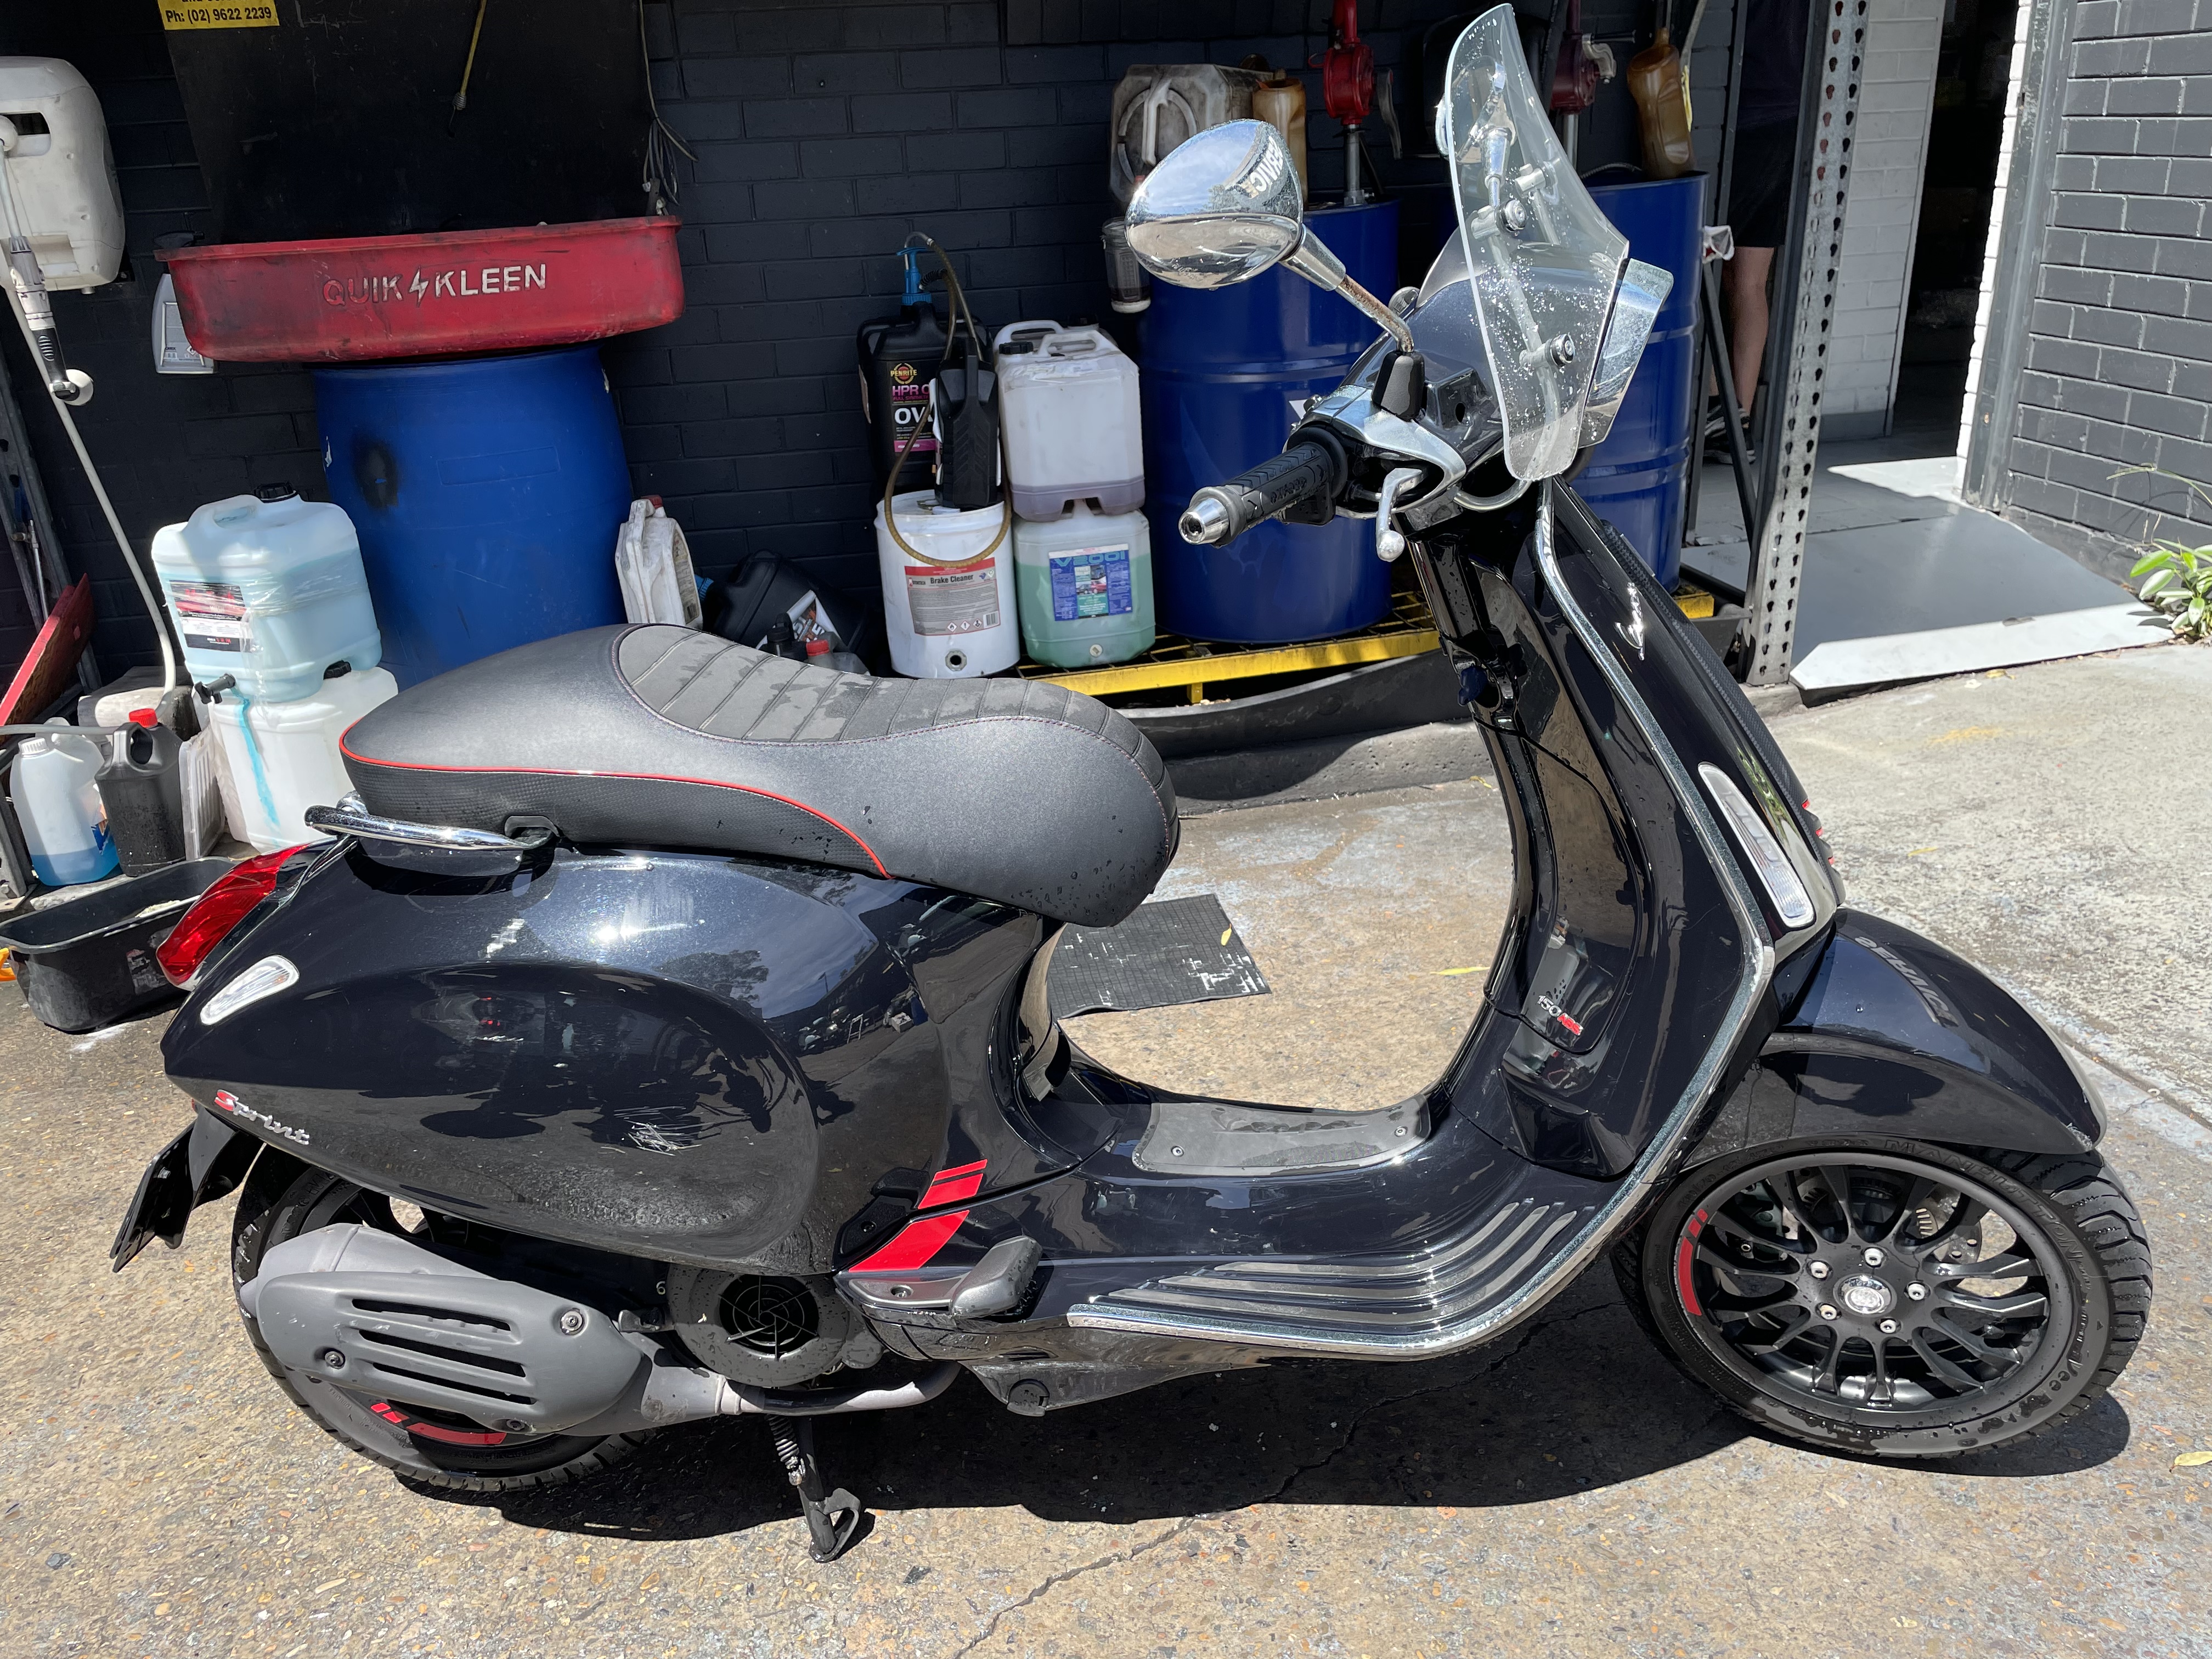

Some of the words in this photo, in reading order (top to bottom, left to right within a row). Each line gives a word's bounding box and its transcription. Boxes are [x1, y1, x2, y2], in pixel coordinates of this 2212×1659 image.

[166, 10, 184, 22] Ph:
[188, 8, 210, 24] (02)
[213, 8, 242, 20] 9622
[245, 7, 271, 20] 2239
[323, 276, 403, 306] QUIK
[436, 264, 546, 298] KLEEN
[890, 369, 918, 377] PENRITE
[892, 385, 919, 396] HPR
[950, 574, 974, 583] Cleaner
[1537, 995, 1562, 1018] 150
[1557, 1012, 1584, 1036] ABS
[215, 1089, 310, 1146] Sprint
